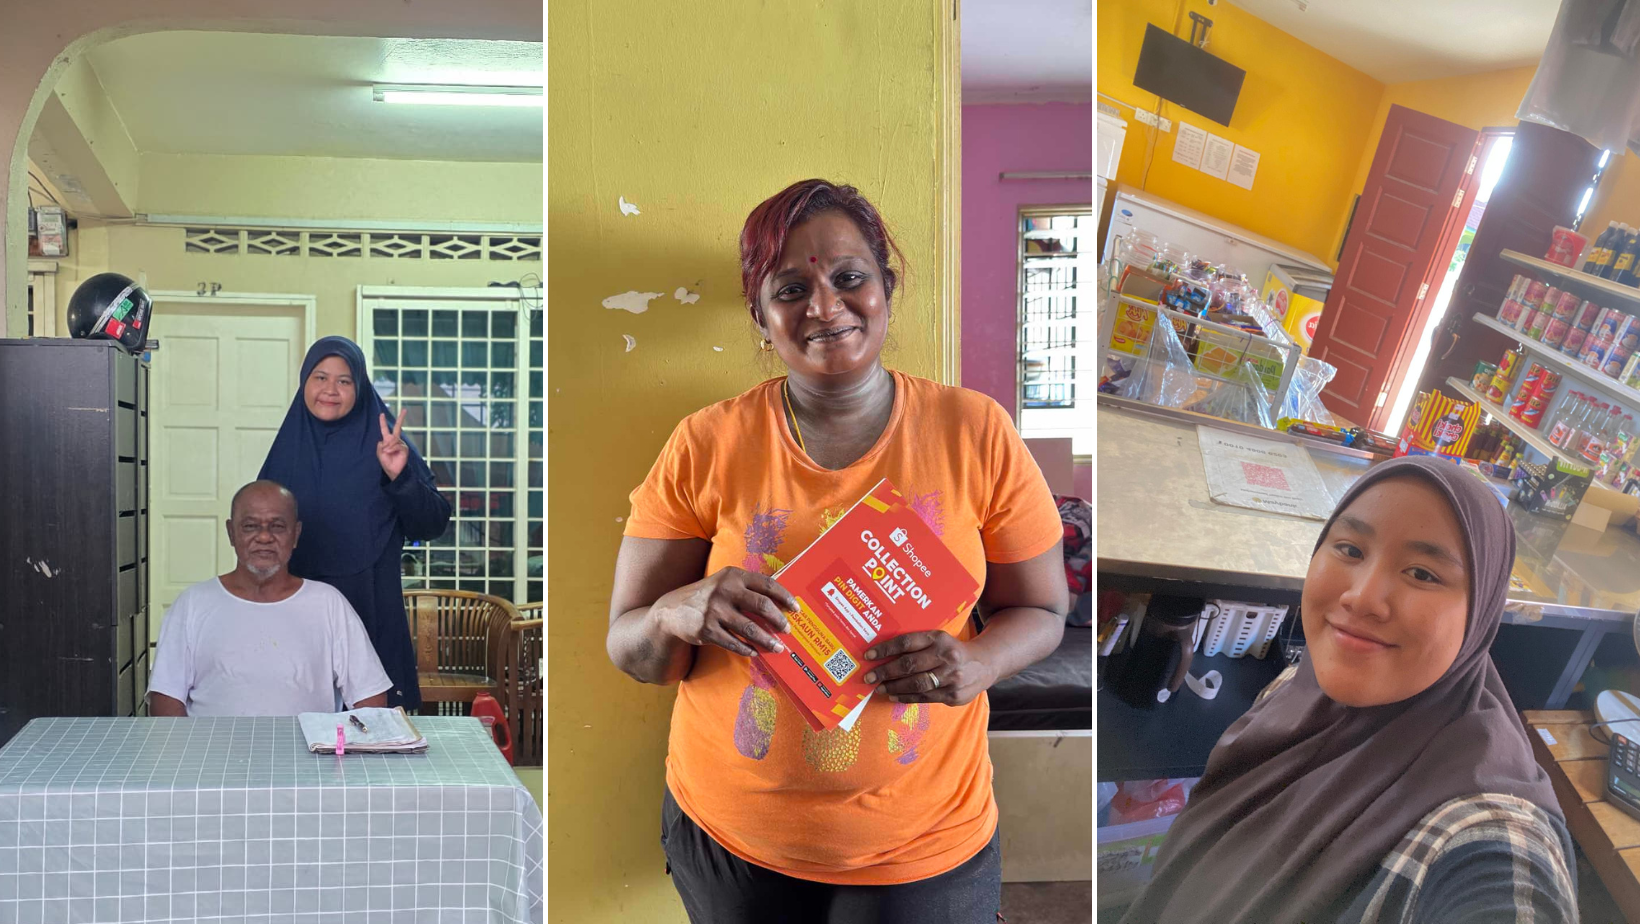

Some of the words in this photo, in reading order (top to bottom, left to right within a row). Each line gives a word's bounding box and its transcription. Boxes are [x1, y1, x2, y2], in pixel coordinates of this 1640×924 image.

[861, 530, 932, 609] COLLECTION
[864, 557, 905, 600] POINT
[903, 543, 931, 577] Shopee
[834, 576, 848, 591] PIN
[845, 590, 865, 610] DIGIT
[863, 610, 882, 631] ANDA
[847, 578, 882, 618] PAMERKAN
[814, 637, 831, 656] RM15
